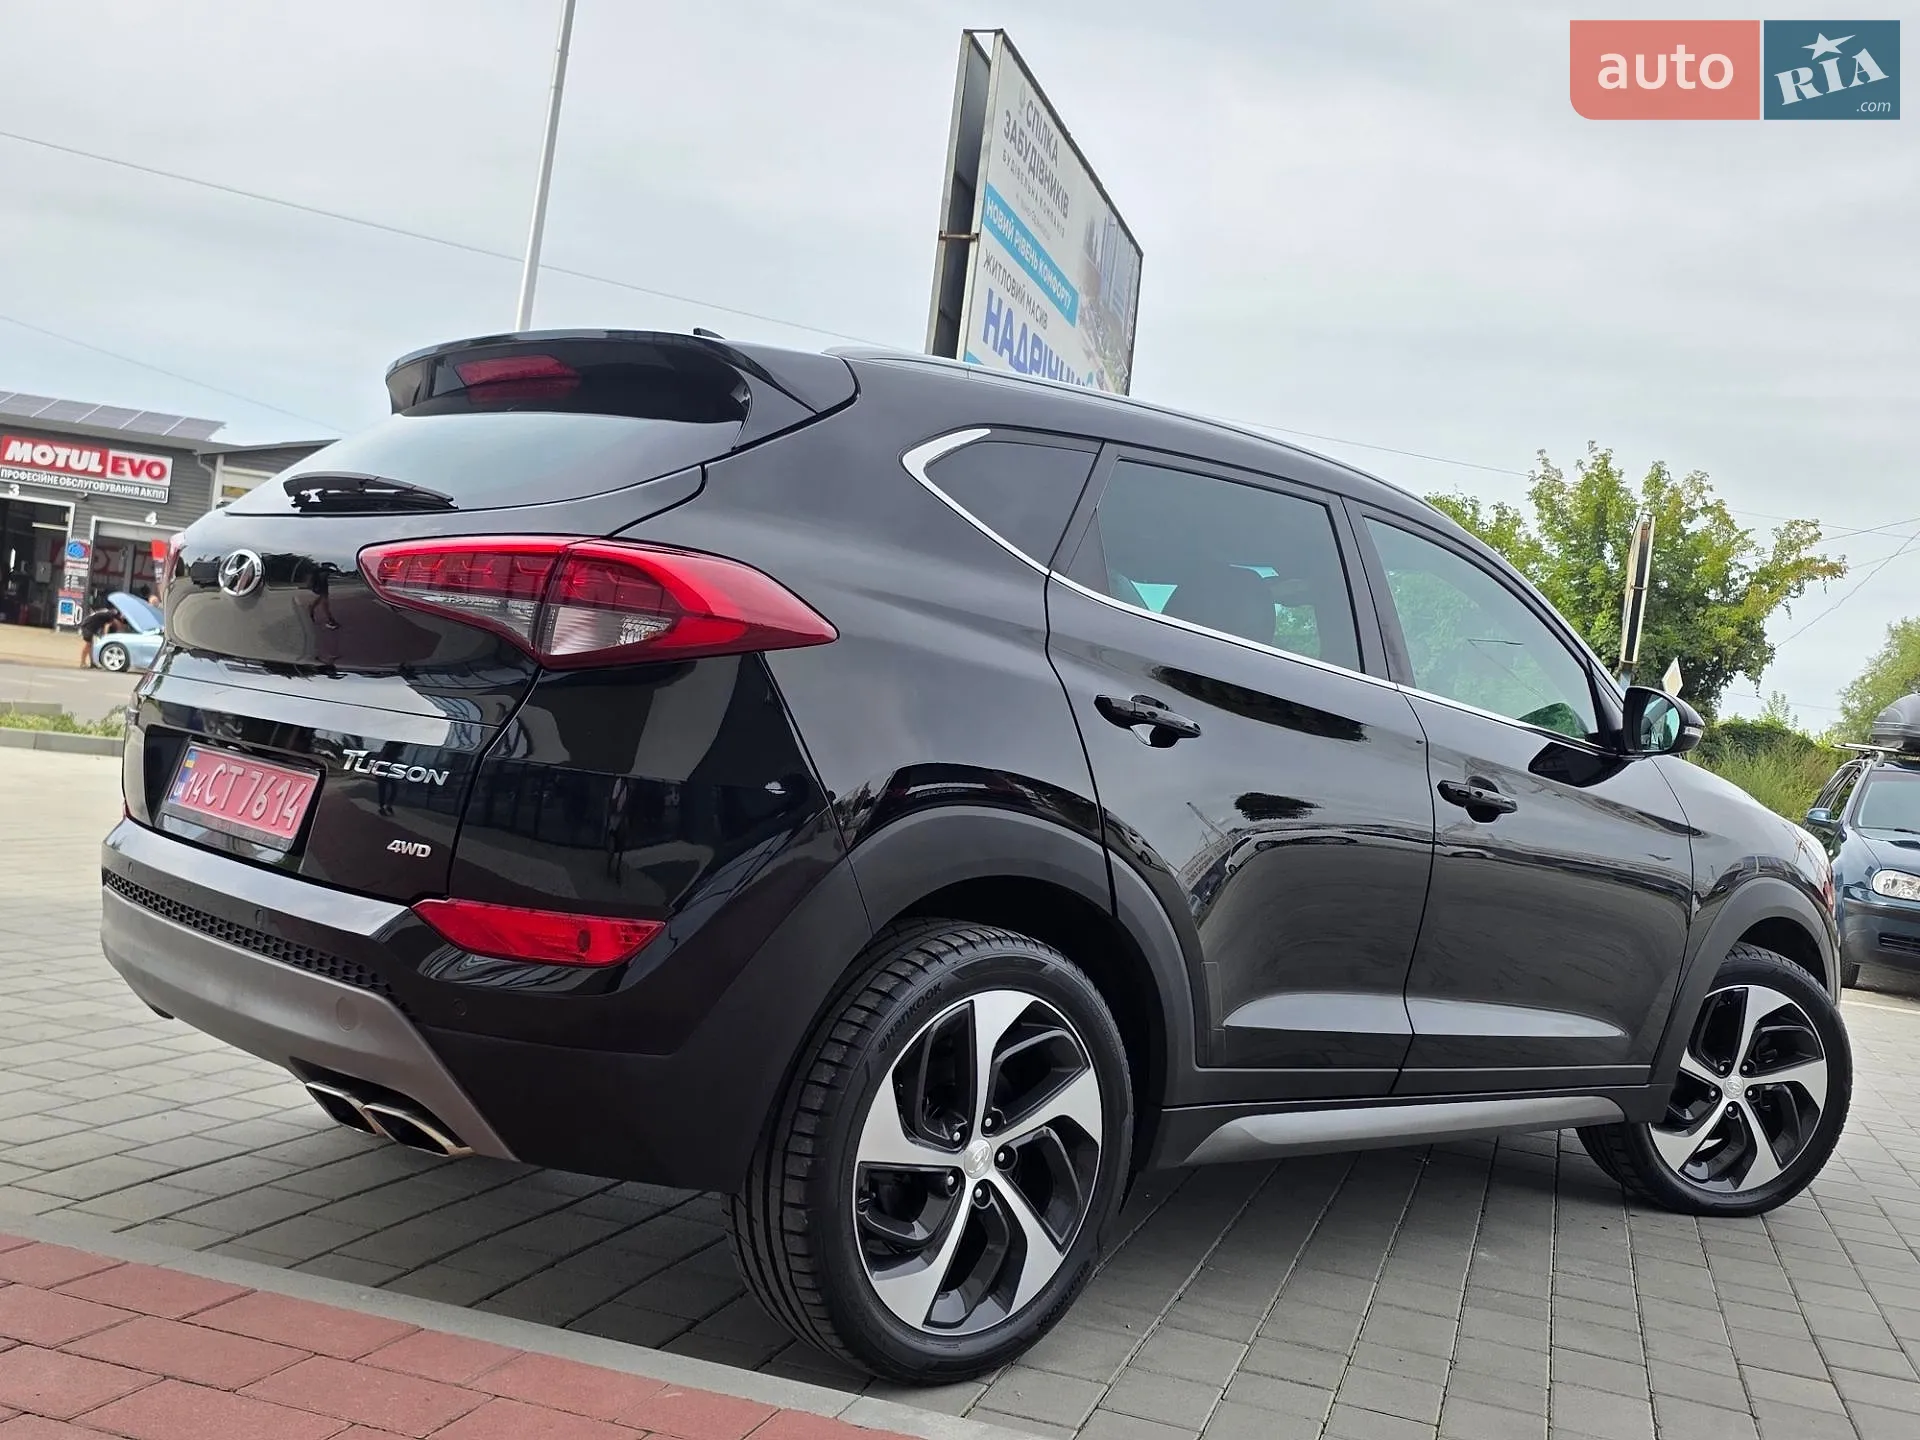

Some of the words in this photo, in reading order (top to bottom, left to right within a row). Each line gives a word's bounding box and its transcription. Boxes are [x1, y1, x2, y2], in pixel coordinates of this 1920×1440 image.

[1026, 99, 1058, 168] СПІЛКА
[1003, 109, 1069, 219] ЗАБУДІВНИКІВ
[986, 196, 1014, 243] НОВИЙ
[1014, 229, 1038, 271] РІВЕНЬ
[1039, 257, 1072, 310] КОМФОРТУ
[983, 248, 1026, 306] ЖИТЛОВИЙ
[1025, 294, 1048, 330] МАСИВ
[4, 440, 104, 473] MOTUL
[110, 455, 168, 481] EVO
[0, 468, 58, 486] ПРОФЕСІЙНЕ
[59, 476, 140, 496] ОБСЛУГОВУВАННЯ
[140, 488, 165, 499] АКПП
[8, 484, 20, 496] 3
[145, 511, 158, 525] 4
[343, 749, 449, 786] TUCSON
[387, 839, 432, 858] 4WD
